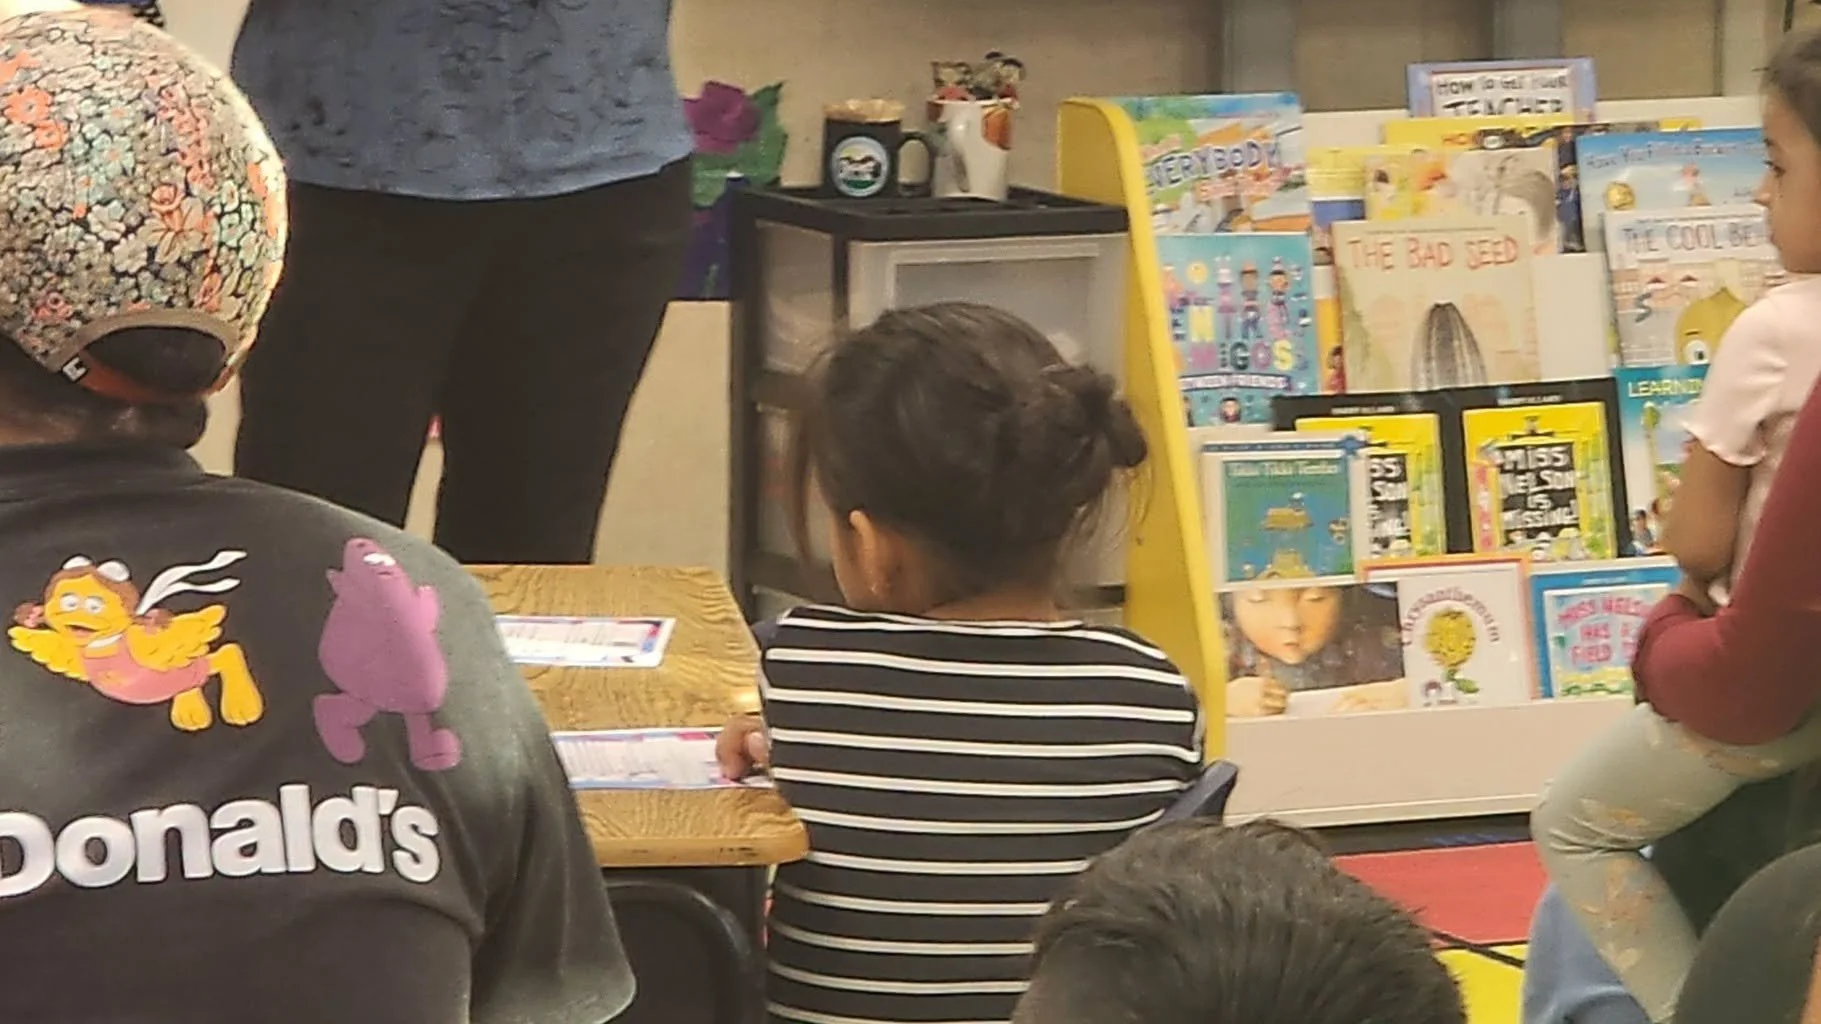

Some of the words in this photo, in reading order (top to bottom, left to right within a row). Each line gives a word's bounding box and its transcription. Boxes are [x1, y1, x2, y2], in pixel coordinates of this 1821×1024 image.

[1621, 226, 1660, 254] THE
[1666, 223, 1723, 251] COOL
[1728, 221, 1769, 248] BE
[1347, 238, 1395, 270] THE
[1406, 237, 1452, 270] BAD
[1465, 235, 1520, 271] SEED
[1501, 444, 1570, 470] MISS
[1526, 494, 1552, 512] IS
